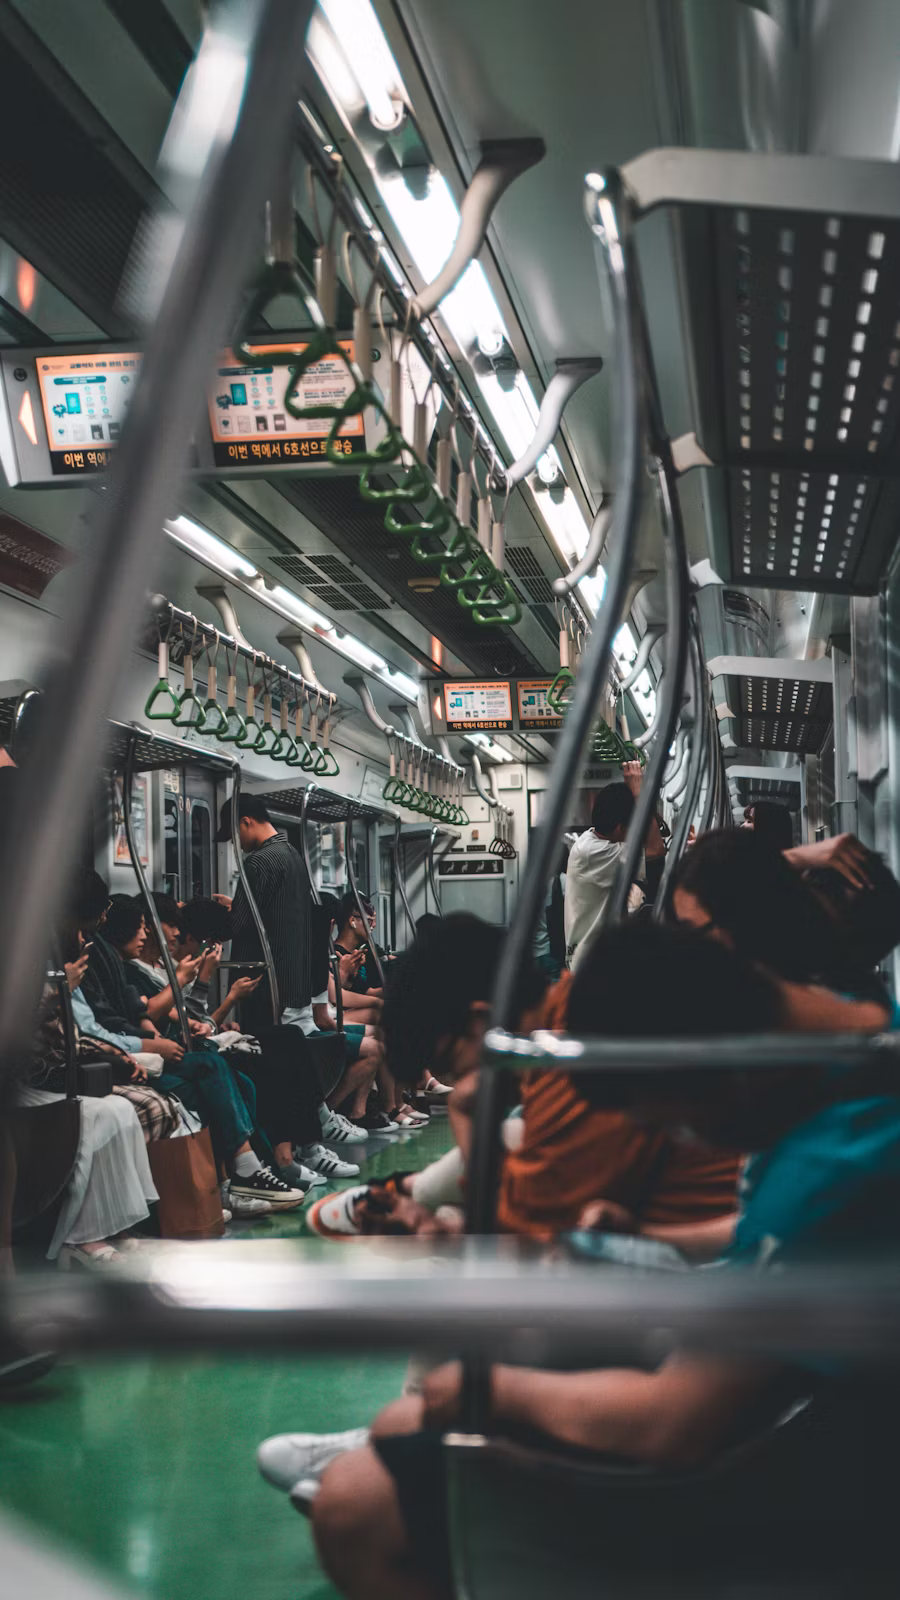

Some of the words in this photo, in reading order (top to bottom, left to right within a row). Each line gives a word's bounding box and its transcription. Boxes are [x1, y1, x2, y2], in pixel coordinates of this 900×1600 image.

[228, 444, 248, 460] 이번
[251, 442, 282, 459] 역에서
[284, 441, 328, 457] 6호선으로
[64, 452, 85, 468] 이번
